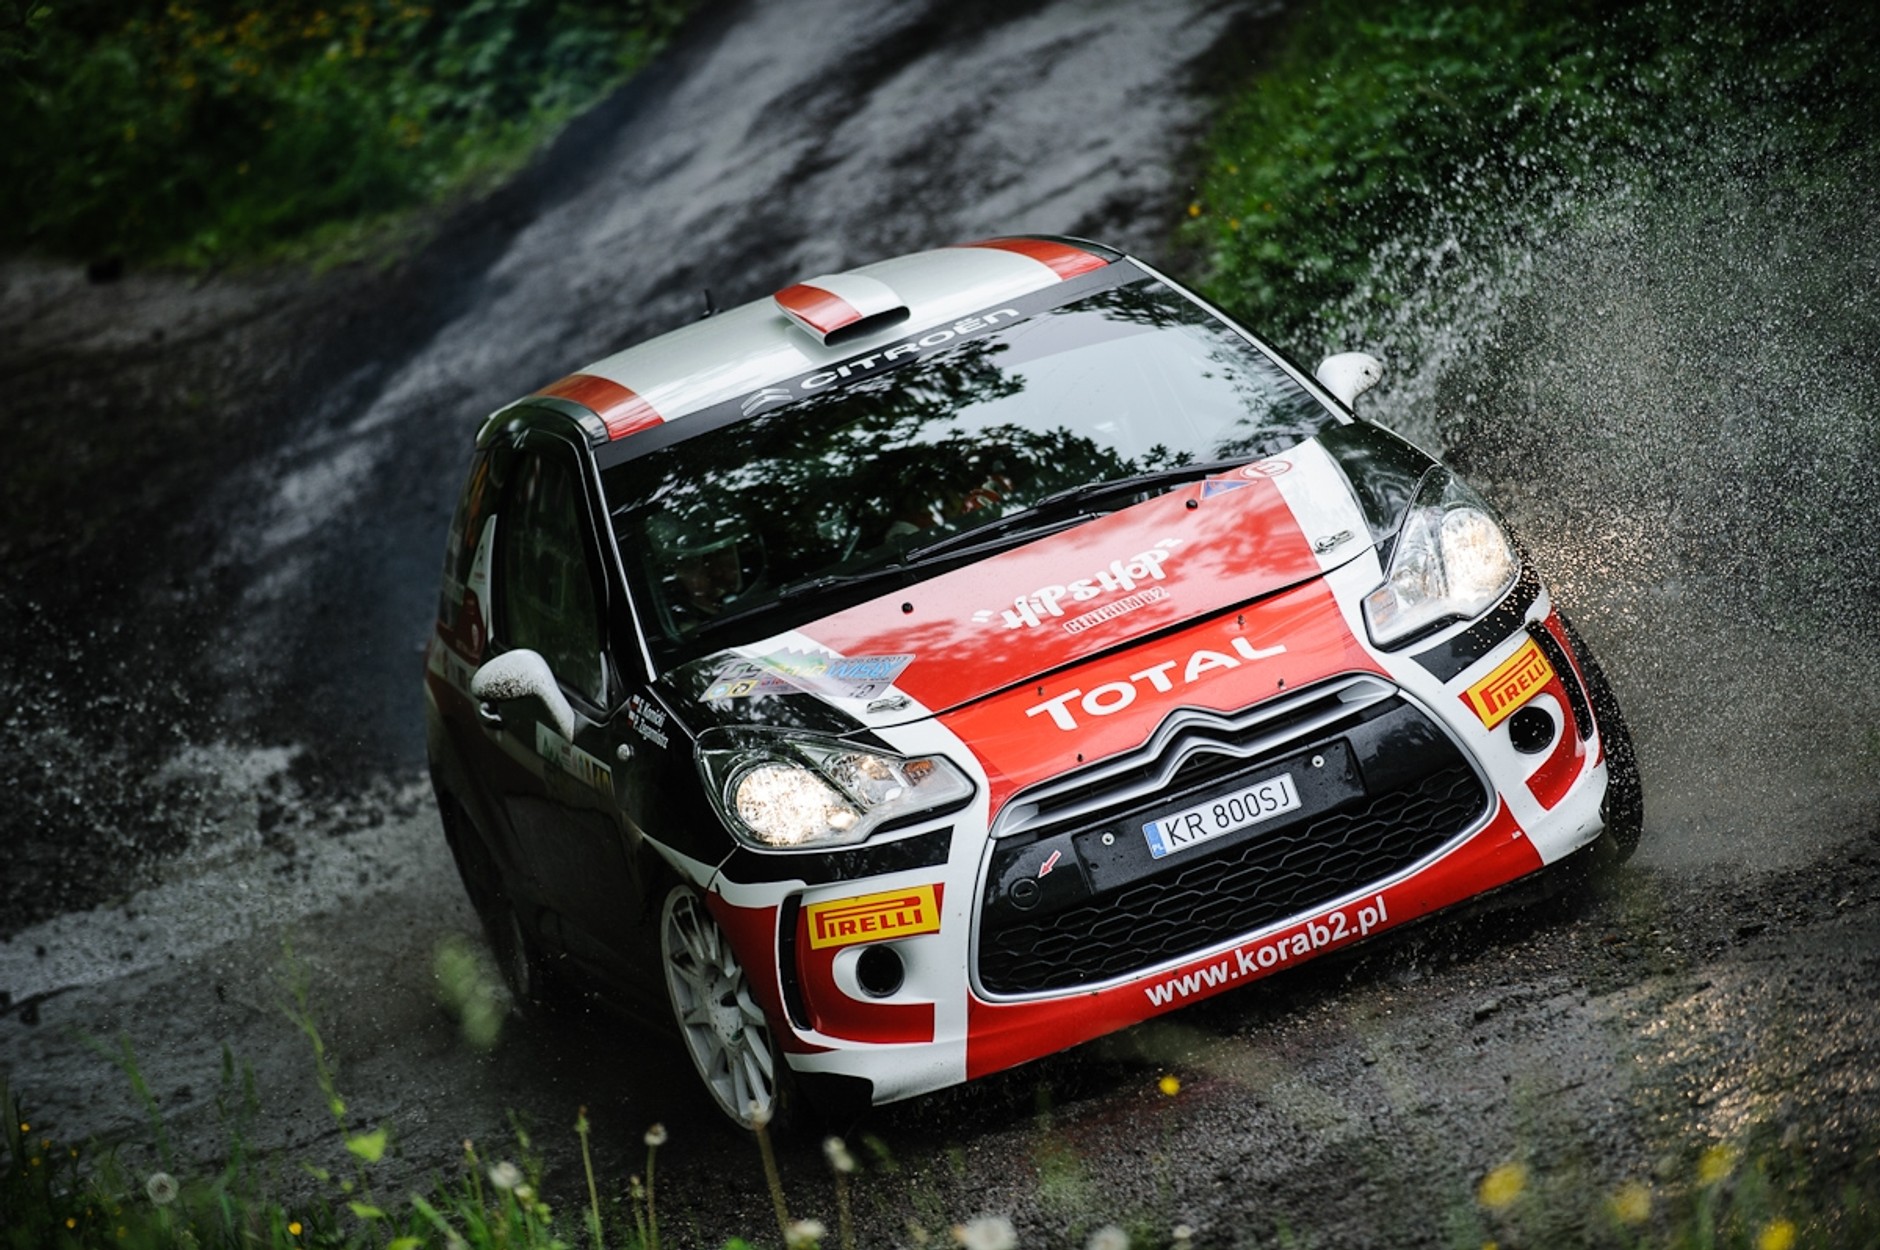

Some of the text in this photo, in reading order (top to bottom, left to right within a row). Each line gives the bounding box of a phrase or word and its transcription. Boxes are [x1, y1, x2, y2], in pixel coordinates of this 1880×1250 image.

[1025, 636, 1287, 731] TOTAL
[1479, 648, 1547, 716] PIRELLI
[1165, 781, 1290, 846] KR 800SJ
[814, 896, 923, 940] PIRELLI
[1144, 895, 1388, 1007] www.korab2.pl
